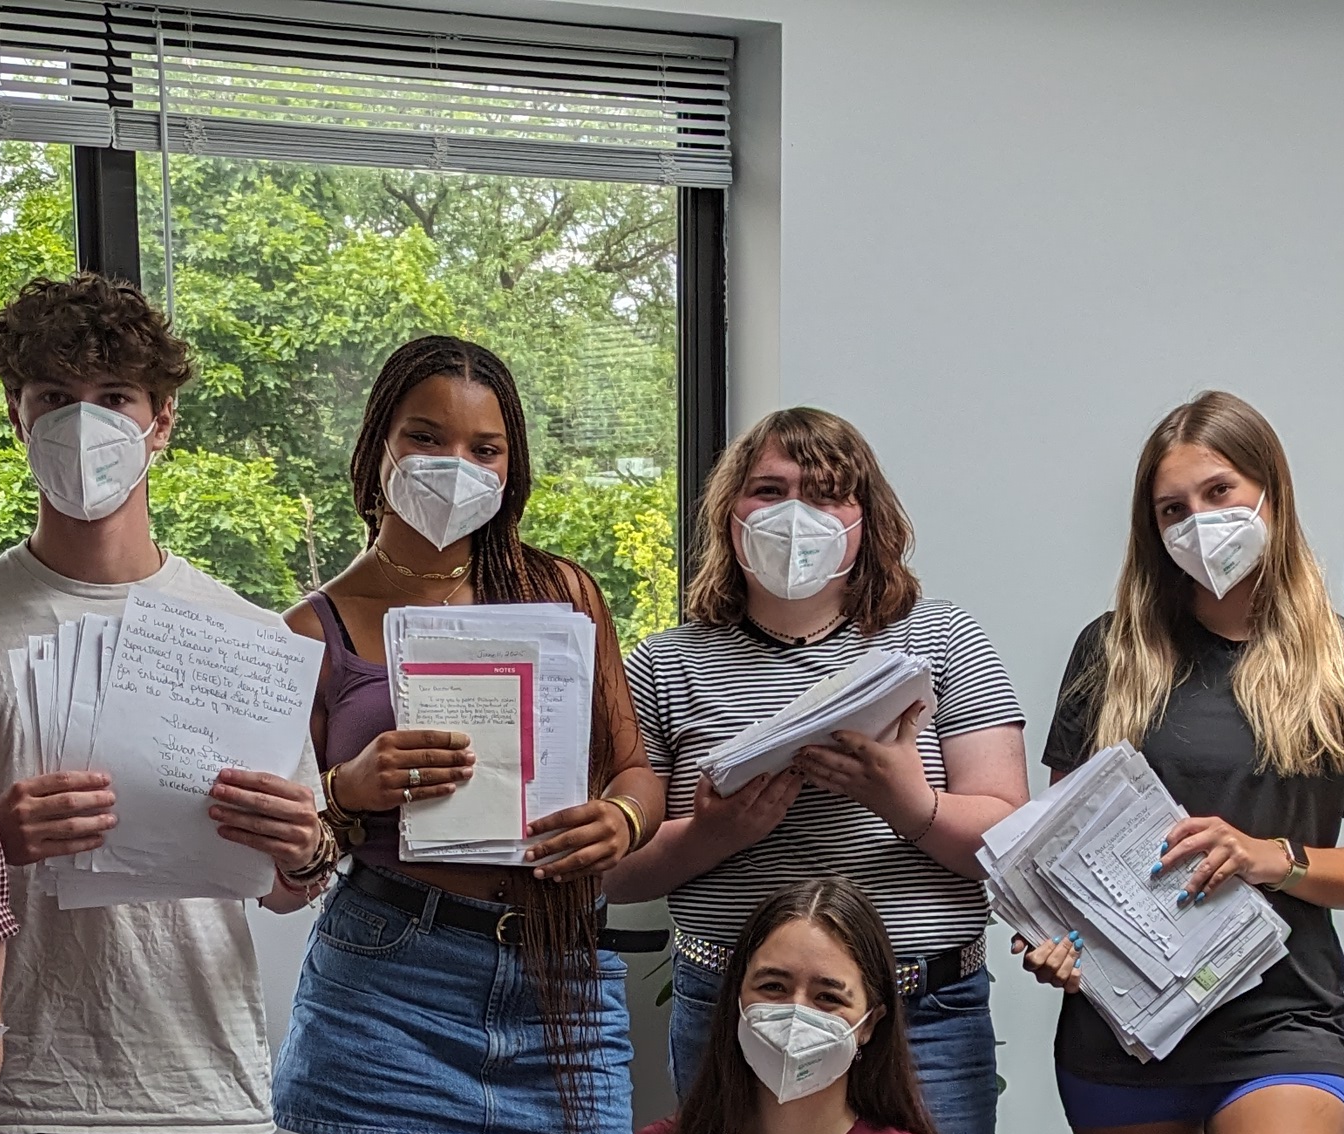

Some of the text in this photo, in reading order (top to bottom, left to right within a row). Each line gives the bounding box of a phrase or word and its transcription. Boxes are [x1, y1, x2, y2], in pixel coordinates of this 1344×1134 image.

[134, 596, 155, 608] Dear
[162, 602, 201, 621] Director
[126, 624, 167, 642] natural
[218, 647, 227, 663] by
[153, 619, 173, 633] urge
[179, 624, 196, 637] you
[199, 629, 213, 639] to
[214, 636, 249, 648] protect
[121, 652, 142, 663] and
[223, 676, 232, 687] to
[259, 685, 273, 697] the
